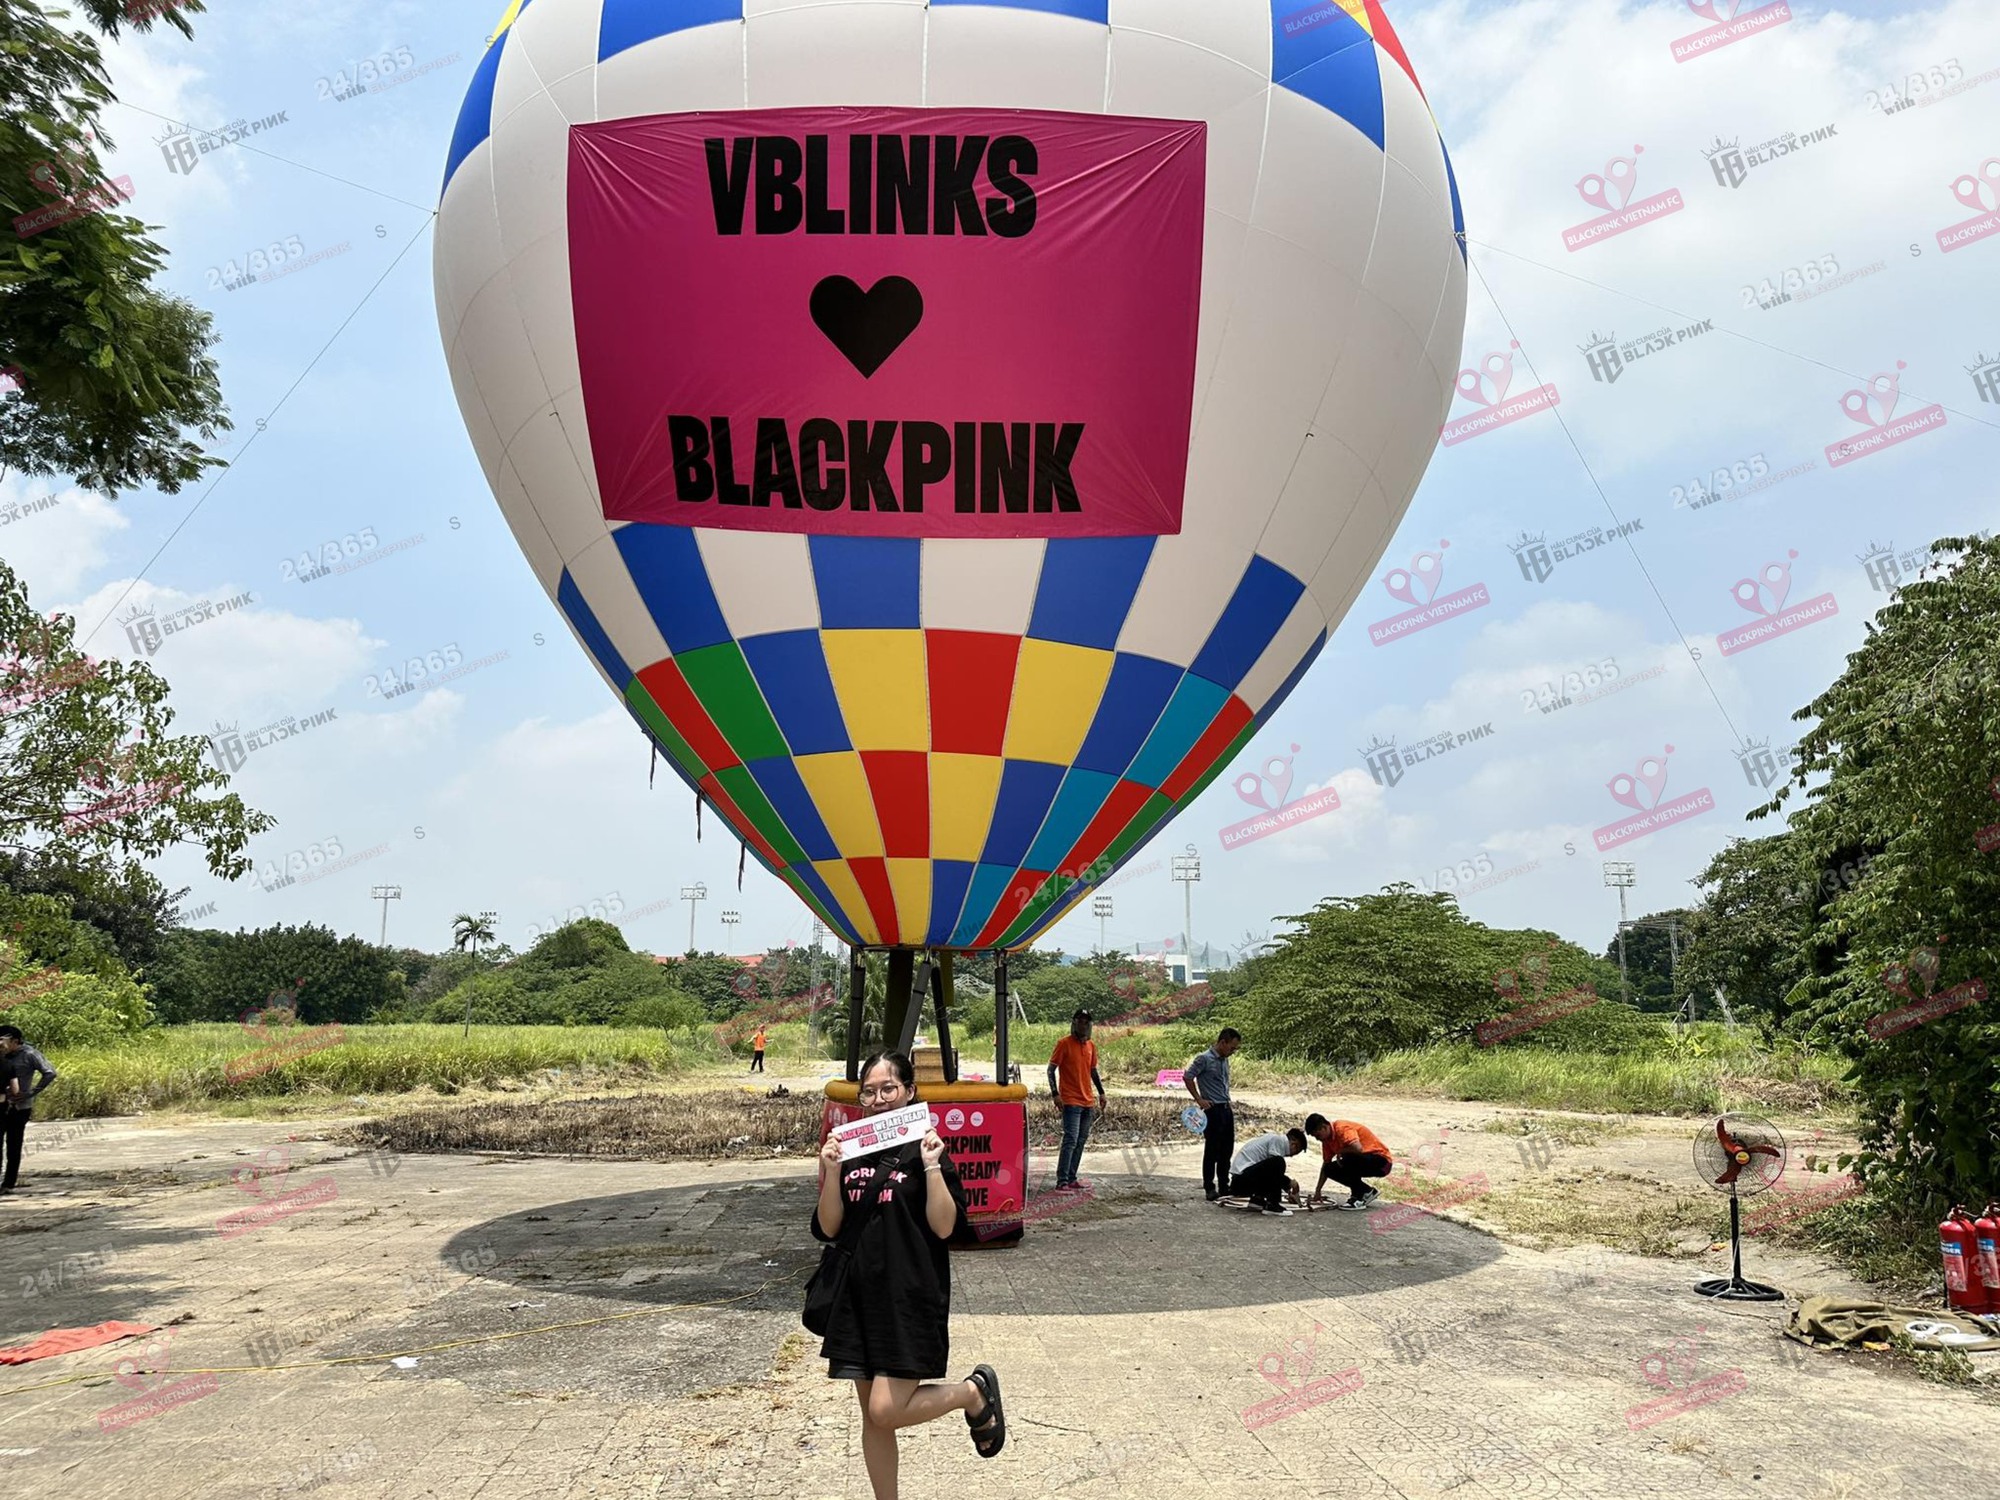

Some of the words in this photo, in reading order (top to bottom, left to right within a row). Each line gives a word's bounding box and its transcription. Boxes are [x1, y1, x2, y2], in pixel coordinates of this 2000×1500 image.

[705, 133, 1038, 238] VBLINKS
[667, 414, 1085, 514] BLACKPINK
[887, 1115, 904, 1129] ARE
